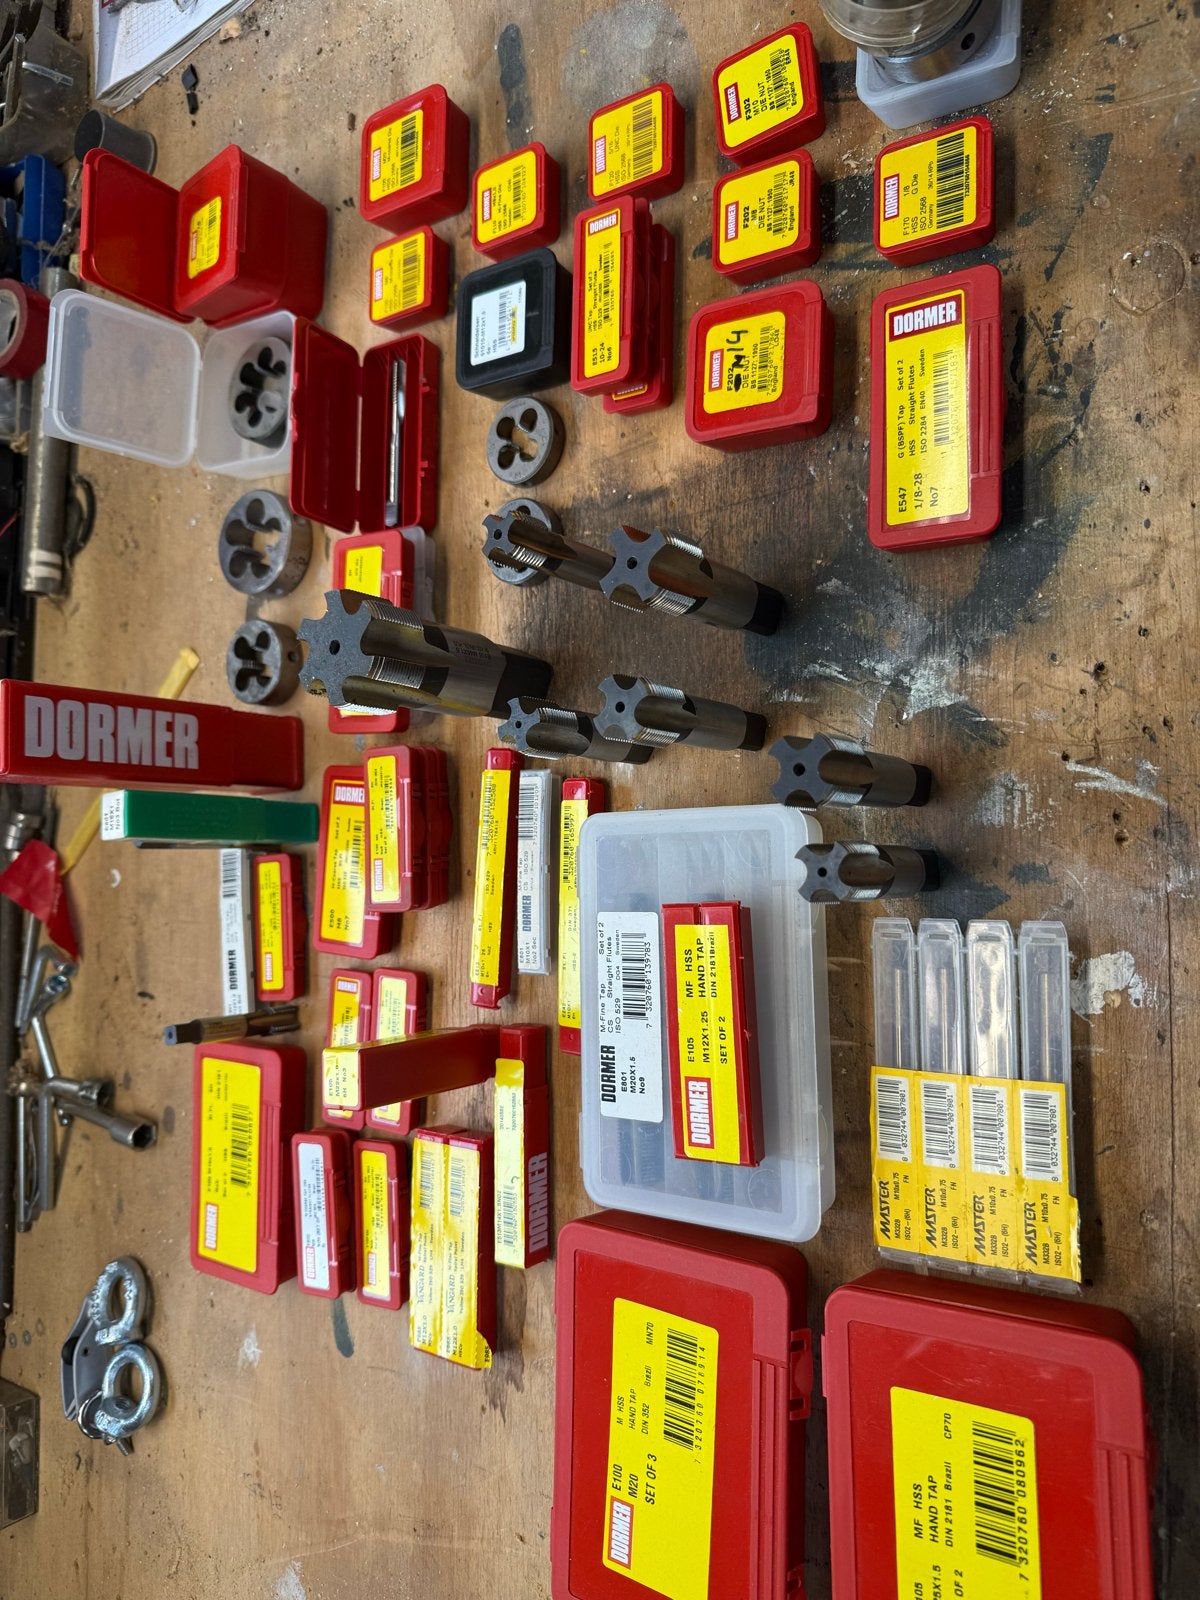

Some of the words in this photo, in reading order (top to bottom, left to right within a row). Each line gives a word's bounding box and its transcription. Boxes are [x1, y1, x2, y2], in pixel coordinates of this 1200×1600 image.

[758, 82, 766, 97] NUT
[789, 81, 798, 106] England
[727, 86, 739, 120] DORMER
[744, 98, 752, 120] F302
[752, 100, 760, 116] M10
[760, 98, 768, 112] DIE
[758, 198, 766, 213] NUT
[884, 176, 898, 218] DORMER
[727, 204, 736, 240] DORMER
[751, 209, 758, 221] M8
[893, 300, 957, 336] DORMER
[711, 352, 721, 388] DORMER
[896, 366, 904, 375] of
[918, 348, 926, 376] Sweden
[726, 368, 734, 392] F202
[742, 374, 750, 388] DIE
[896, 378, 904, 390] Set
[907, 365, 916, 390] Flutes
[897, 404, 906, 420] Tap
[907, 392, 916, 424] Straight
[896, 422, 906, 450] (BSPF)
[908, 440, 916, 456] HSS
[898, 486, 907, 512] E547
[913, 472, 924, 509] 1/8-28
[930, 486, 939, 507] No7
[24, 695, 200, 769] DORMER
[522, 896, 532, 932] DORMER
[598, 930, 605, 938] of
[598, 940, 606, 955] Set
[605, 936, 613, 962] Flutes
[644, 941, 652, 974] 139783
[696, 937, 705, 960] TAP
[228, 950, 238, 990] DORMER
[684, 948, 693, 972] HSS
[599, 983, 608, 1000] Tap
[606, 965, 614, 998] Straight
[685, 980, 694, 998] MF
[696, 964, 706, 998] HAND
[710, 981, 718, 998] DIN
[614, 998, 622, 1014] 529
[644, 978, 652, 1012] 320760
[607, 1019, 614, 1033] CS
[614, 1016, 622, 1034] ISO
[700, 1010, 710, 1064] M12X1.25
[718, 1026, 727, 1040] OF
[686, 1037, 695, 1062] E105
[719, 1044, 728, 1064] SET
[600, 1045, 616, 1102] DORMER
[620, 1072, 628, 1092] E801
[629, 1056, 637, 1094] M20X1.5
[638, 1076, 646, 1094] No9
[688, 1080, 712, 1145] DORMER
[900, 1118, 908, 1148] 032744
[892, 1172, 900, 1200] M10x0.75
[902, 1174, 910, 1184] FN
[950, 1182, 957, 1190] FN
[528, 1152, 548, 1254] DORMER
[939, 1179, 948, 1208] M10x0.75
[988, 1186, 996, 1215] M10x0.75
[1000, 1188, 1007, 1198] FN
[1052, 1196, 1060, 1205] FN
[878, 1180, 890, 1240] MASTER
[924, 1188, 937, 1248] MASTER
[1040, 1193, 1049, 1222] M10x0.75
[972, 1194, 986, 1256] MASTER
[1024, 1201, 1038, 1266] MASTER
[646, 1322, 654, 1345] MN70
[643, 1365, 652, 1387] Brazil
[616, 1396, 624, 1412] HSS
[630, 1388, 638, 1404] TAP
[628, 1406, 637, 1430] HAND
[642, 1402, 650, 1418] 352
[640, 1421, 650, 1434] DIN
[694, 1403, 704, 1450] 320760
[944, 1412, 952, 1440] CP70
[647, 1454, 658, 1462] 3
[1014, 1438, 1027, 1498] 080962
[612, 1464, 623, 1491] E100
[646, 1464, 656, 1479] OF
[944, 1461, 952, 1491] Brazil
[628, 1474, 638, 1498] M20
[645, 1482, 656, 1504] SET
[912, 1482, 922, 1510] HSS
[928, 1475, 938, 1500] TAP
[944, 1498, 954, 1525] 2181
[610, 1500, 631, 1564] DORMER
[914, 1518, 924, 1539] MF
[928, 1505, 939, 1544] HAND
[1016, 1506, 1029, 1566] 320760
[944, 1528, 954, 1548] DIN
[932, 1565, 942, 1600] 5X1.5
[954, 1569, 964, 1577] 2
[914, 1582, 924, 1600] 105
[954, 1580, 964, 1598] OF
